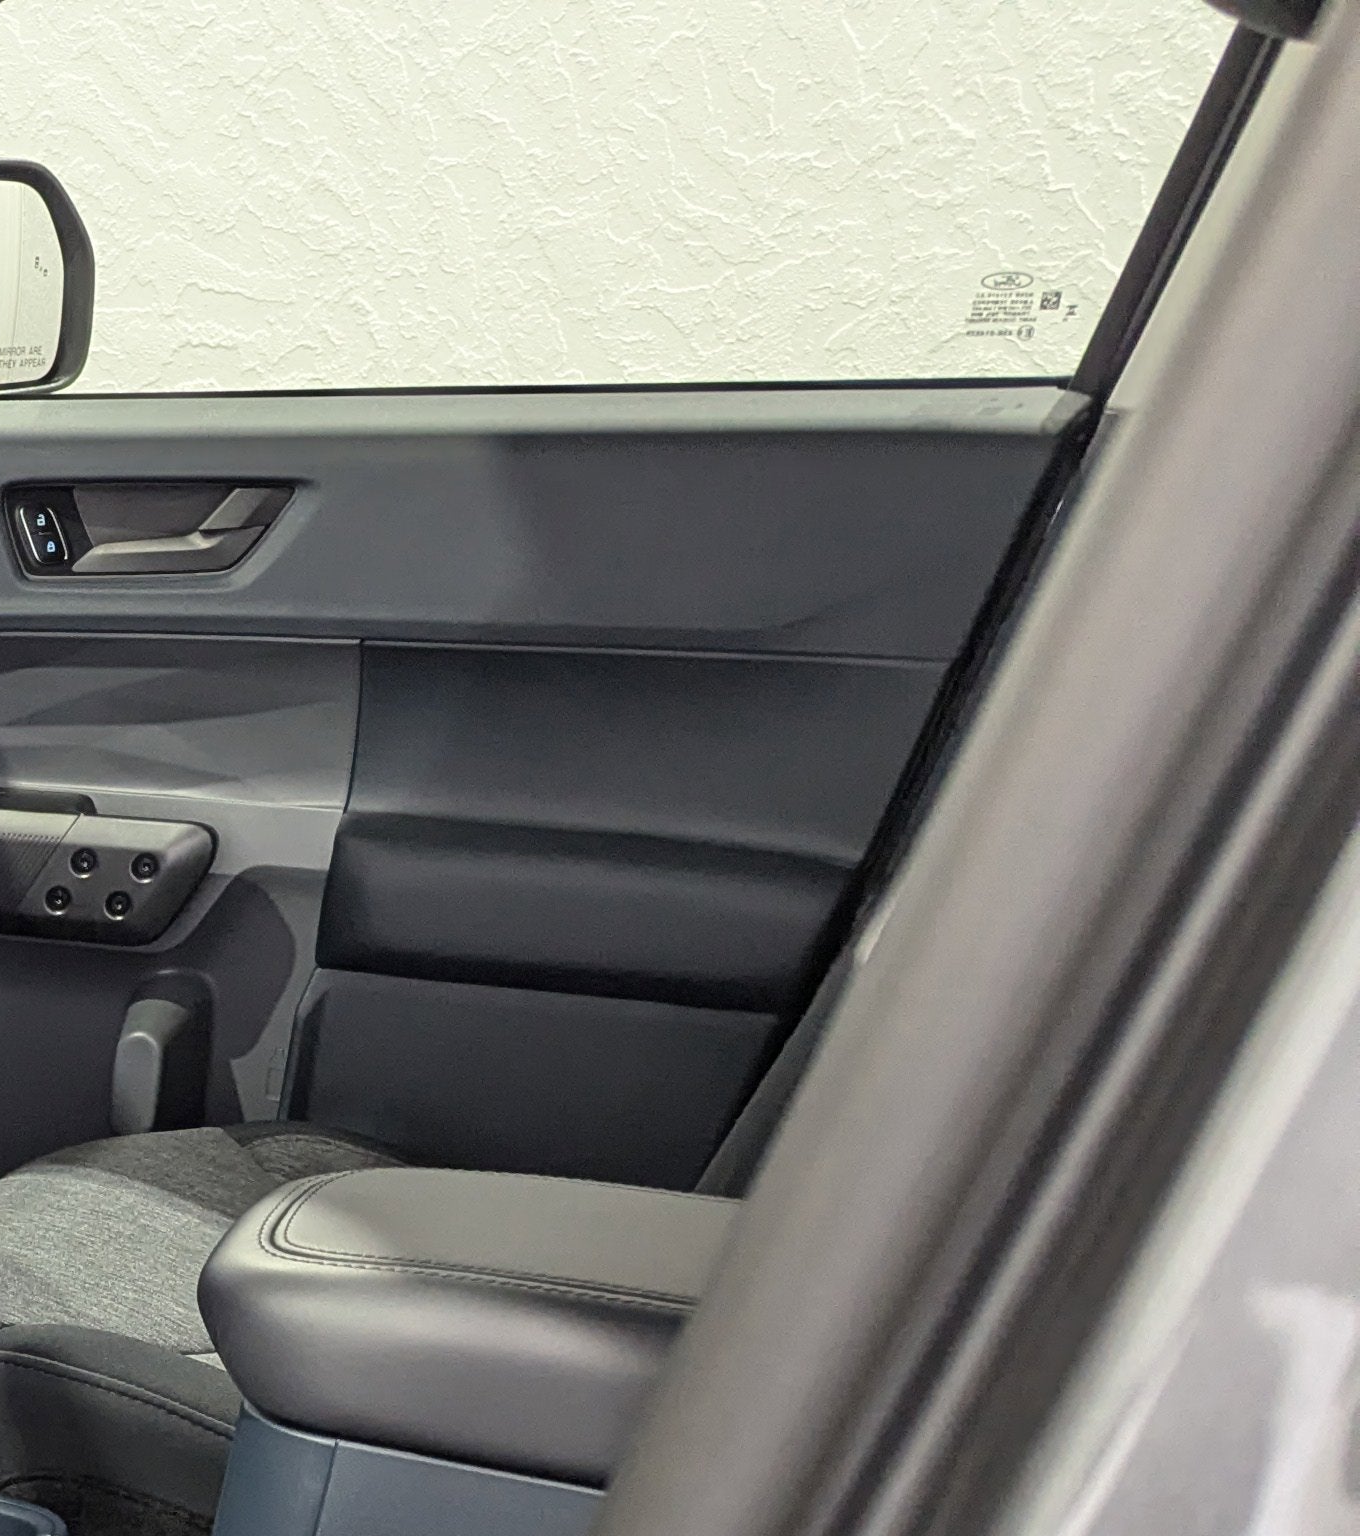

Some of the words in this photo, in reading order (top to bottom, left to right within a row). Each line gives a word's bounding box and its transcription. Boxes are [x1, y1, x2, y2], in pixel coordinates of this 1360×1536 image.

[0, 346, 26, 356] MIRROR
[29, 345, 43, 355] ARE
[0, 359, 16, 369] THEY
[19, 358, 46, 368] APPEAR
